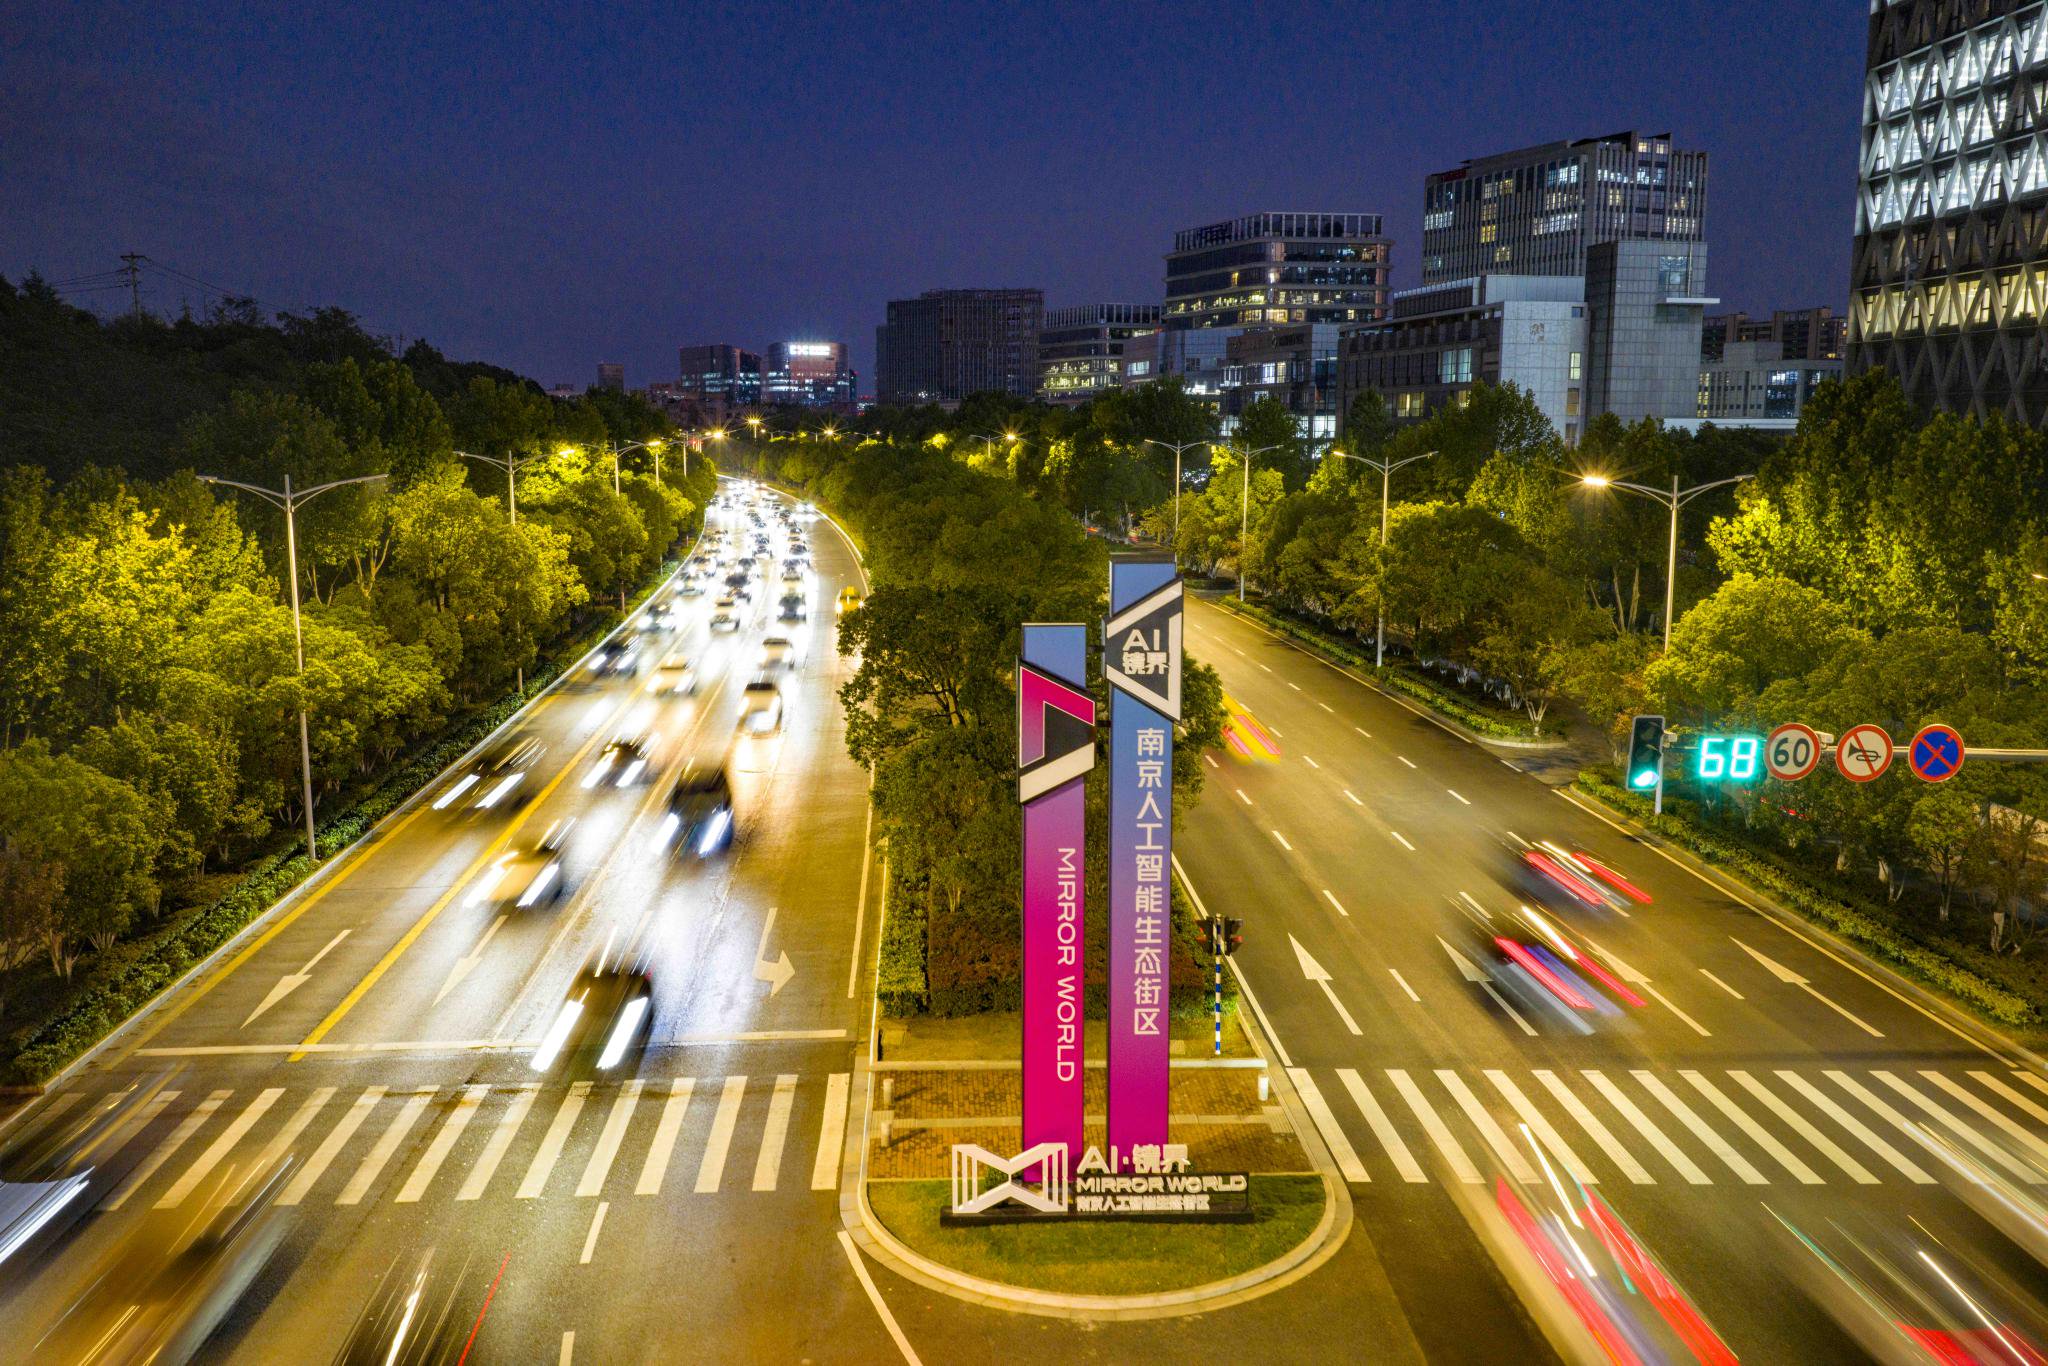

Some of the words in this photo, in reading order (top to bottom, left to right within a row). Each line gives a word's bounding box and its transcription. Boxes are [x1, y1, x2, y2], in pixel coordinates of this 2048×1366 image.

[1122, 629, 1160, 651] AI
[1700, 738, 1757, 777] 68
[1774, 738, 1810, 768] 60
[1134, 728, 1165, 1035] 南京人工智能生态街区
[1057, 848, 1076, 966] MIRROR
[1056, 976, 1076, 1082] WORLD
[1077, 1176, 1164, 1194] MIRROR
[1167, 1174, 1248, 1194] WORLD
